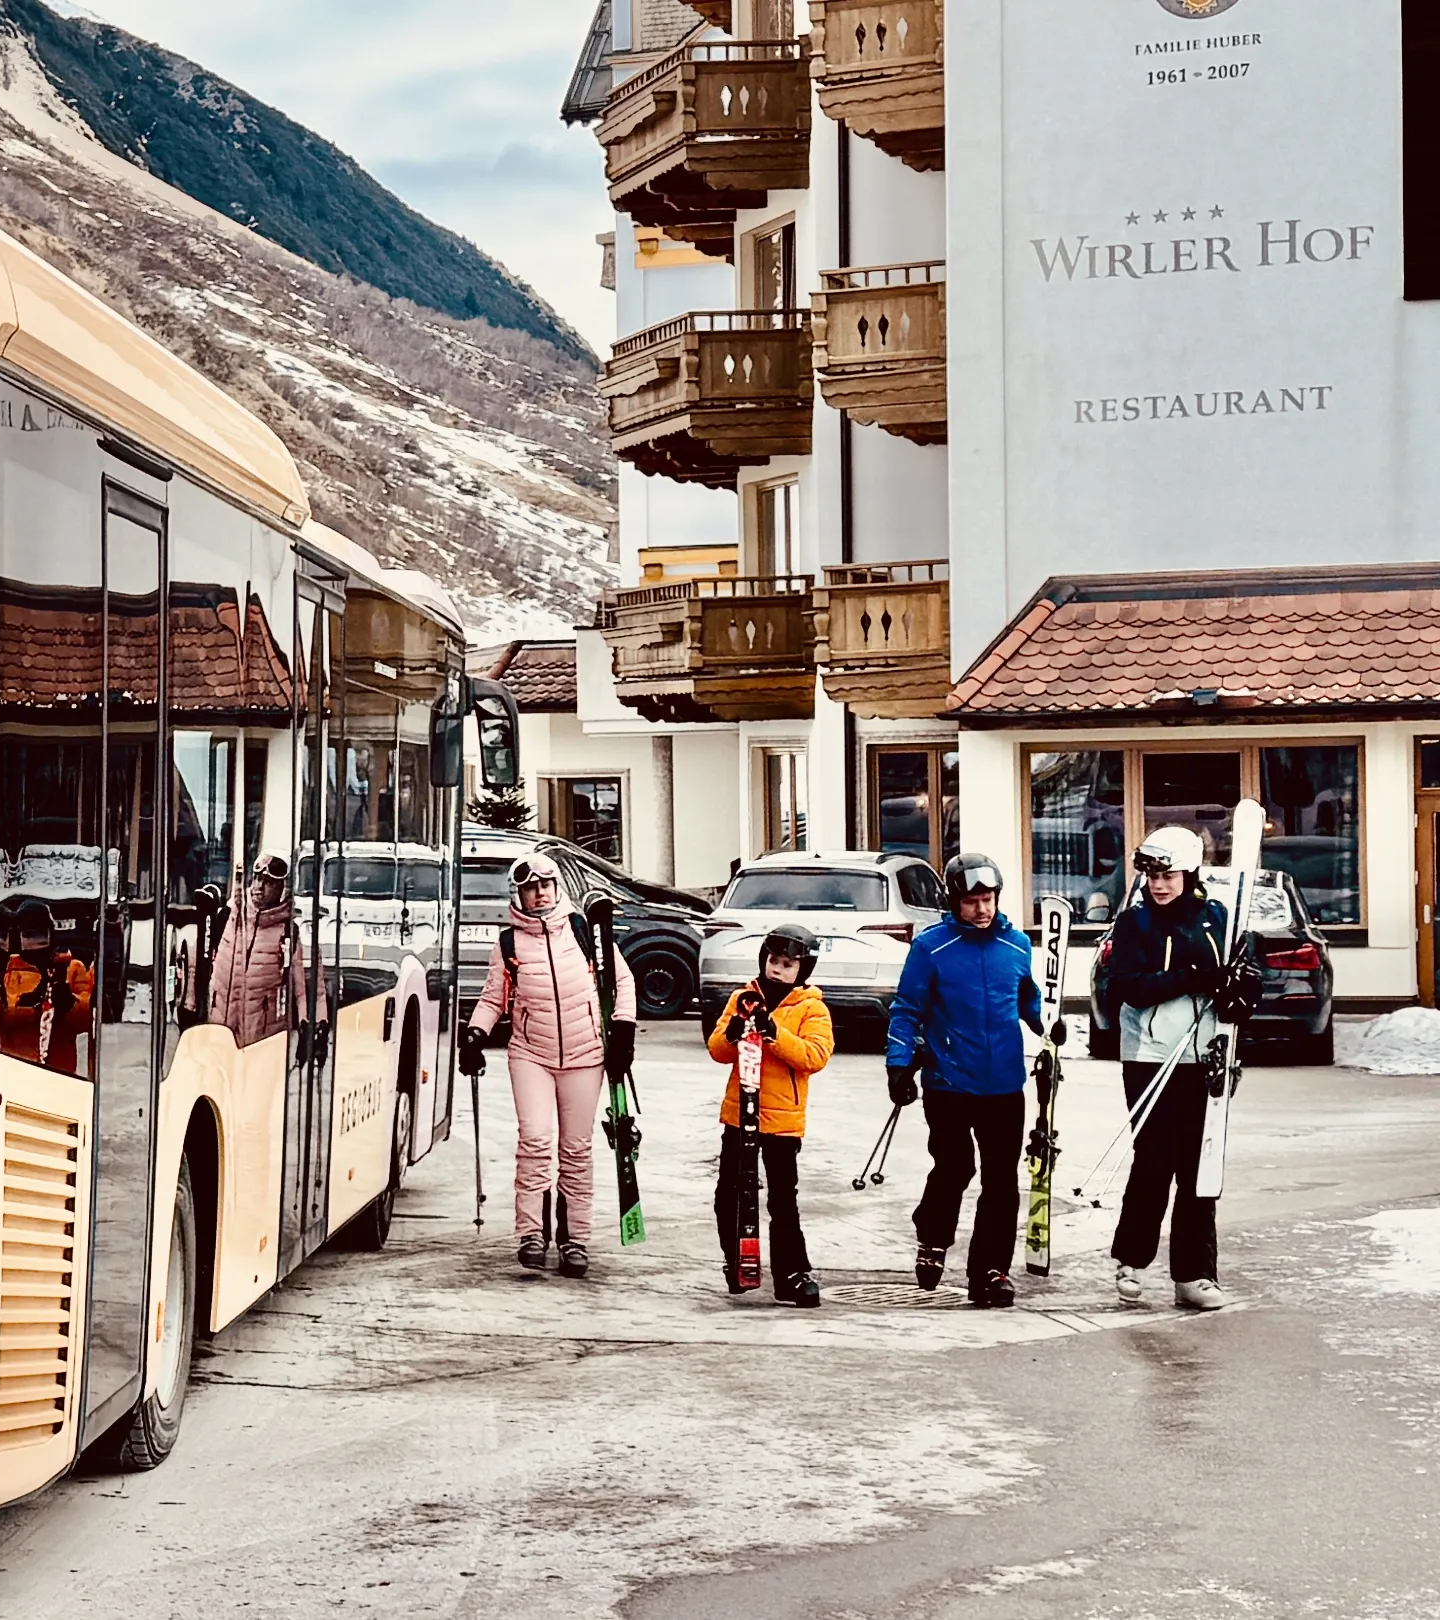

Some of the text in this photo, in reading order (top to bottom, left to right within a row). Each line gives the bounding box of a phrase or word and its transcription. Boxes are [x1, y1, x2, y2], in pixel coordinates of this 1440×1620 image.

[1135, 33, 1263, 56] FAMILIE HUBER
[1146, 68, 1188, 86] 1961
[1207, 63, 1251, 81] 2007
[1030, 219, 1374, 283] WIRLER HOF
[1073, 385, 1333, 424] RESTAURANT
[1044, 911, 1062, 1005] HEAD
[737, 1040, 763, 1089] HERO
